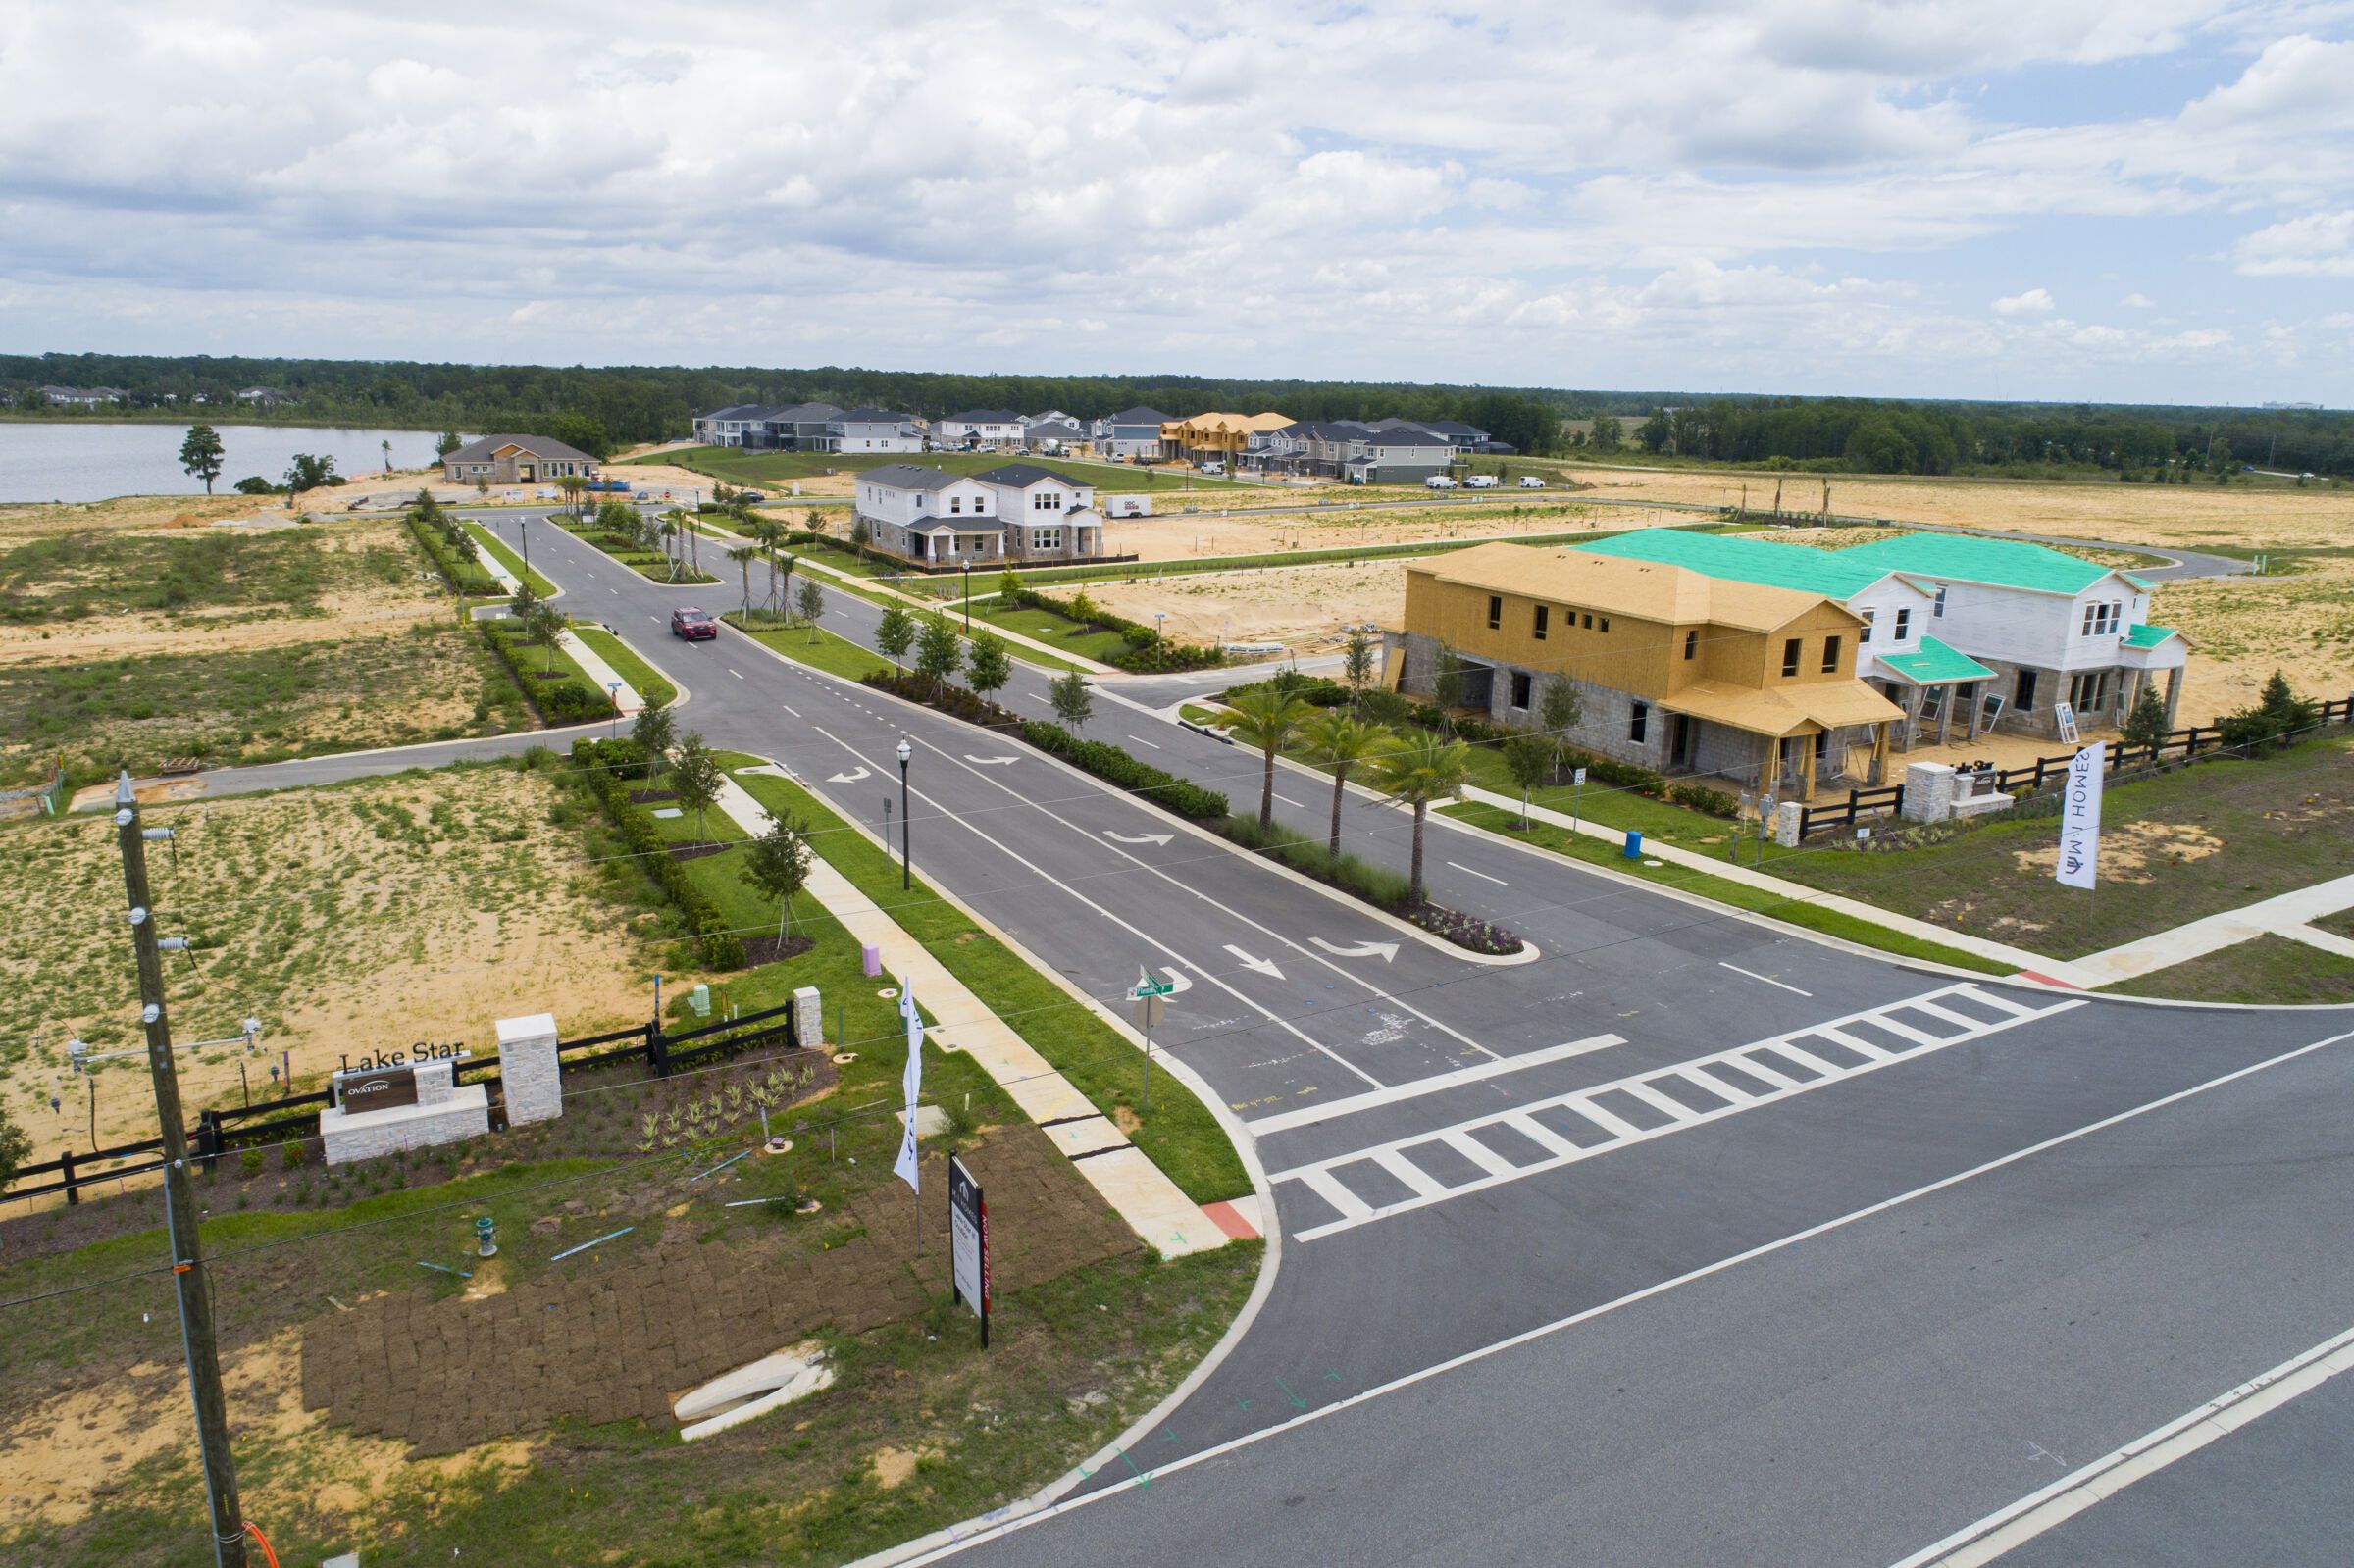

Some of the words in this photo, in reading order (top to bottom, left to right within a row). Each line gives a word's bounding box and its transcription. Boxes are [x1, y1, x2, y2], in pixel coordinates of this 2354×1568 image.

[339, 1048, 404, 1074] Lake
[412, 1041, 464, 1063] Star
[348, 1083, 389, 1096] OVATION
